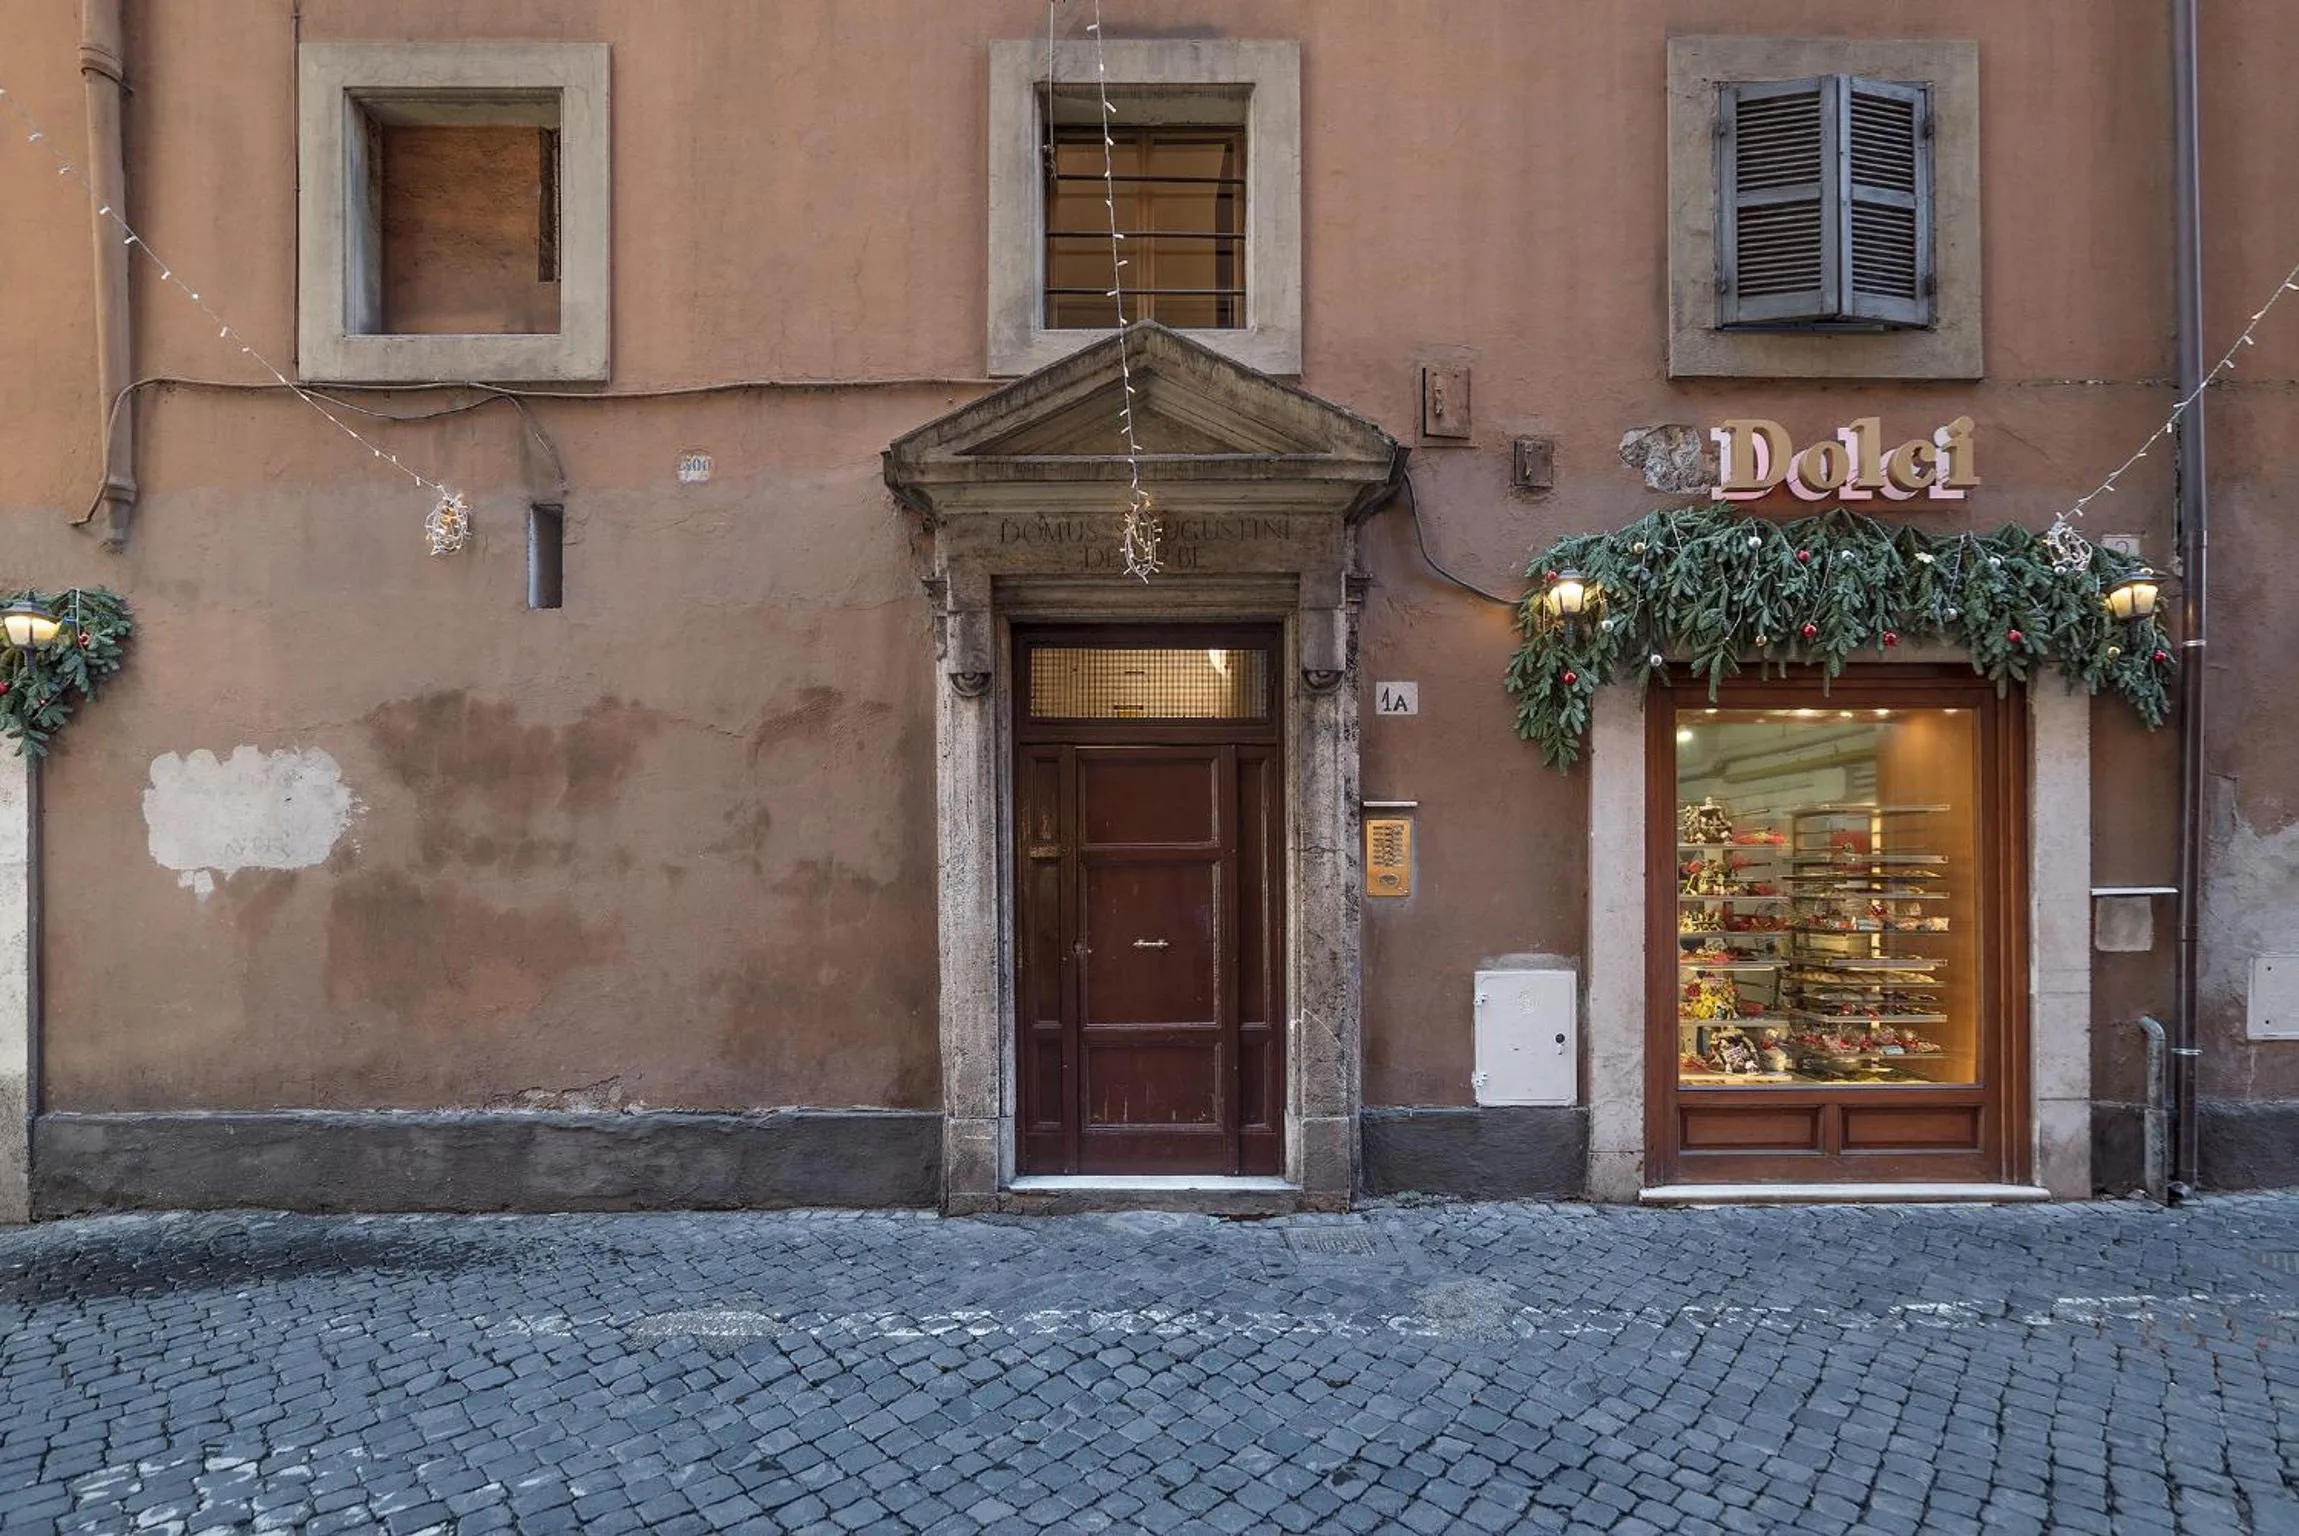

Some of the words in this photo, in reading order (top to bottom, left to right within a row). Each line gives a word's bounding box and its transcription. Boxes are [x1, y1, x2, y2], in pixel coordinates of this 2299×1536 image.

[1710, 415, 1981, 500] Dolci
[1000, 519, 1098, 543] DOMUS
[1381, 687, 1408, 712] 1A
